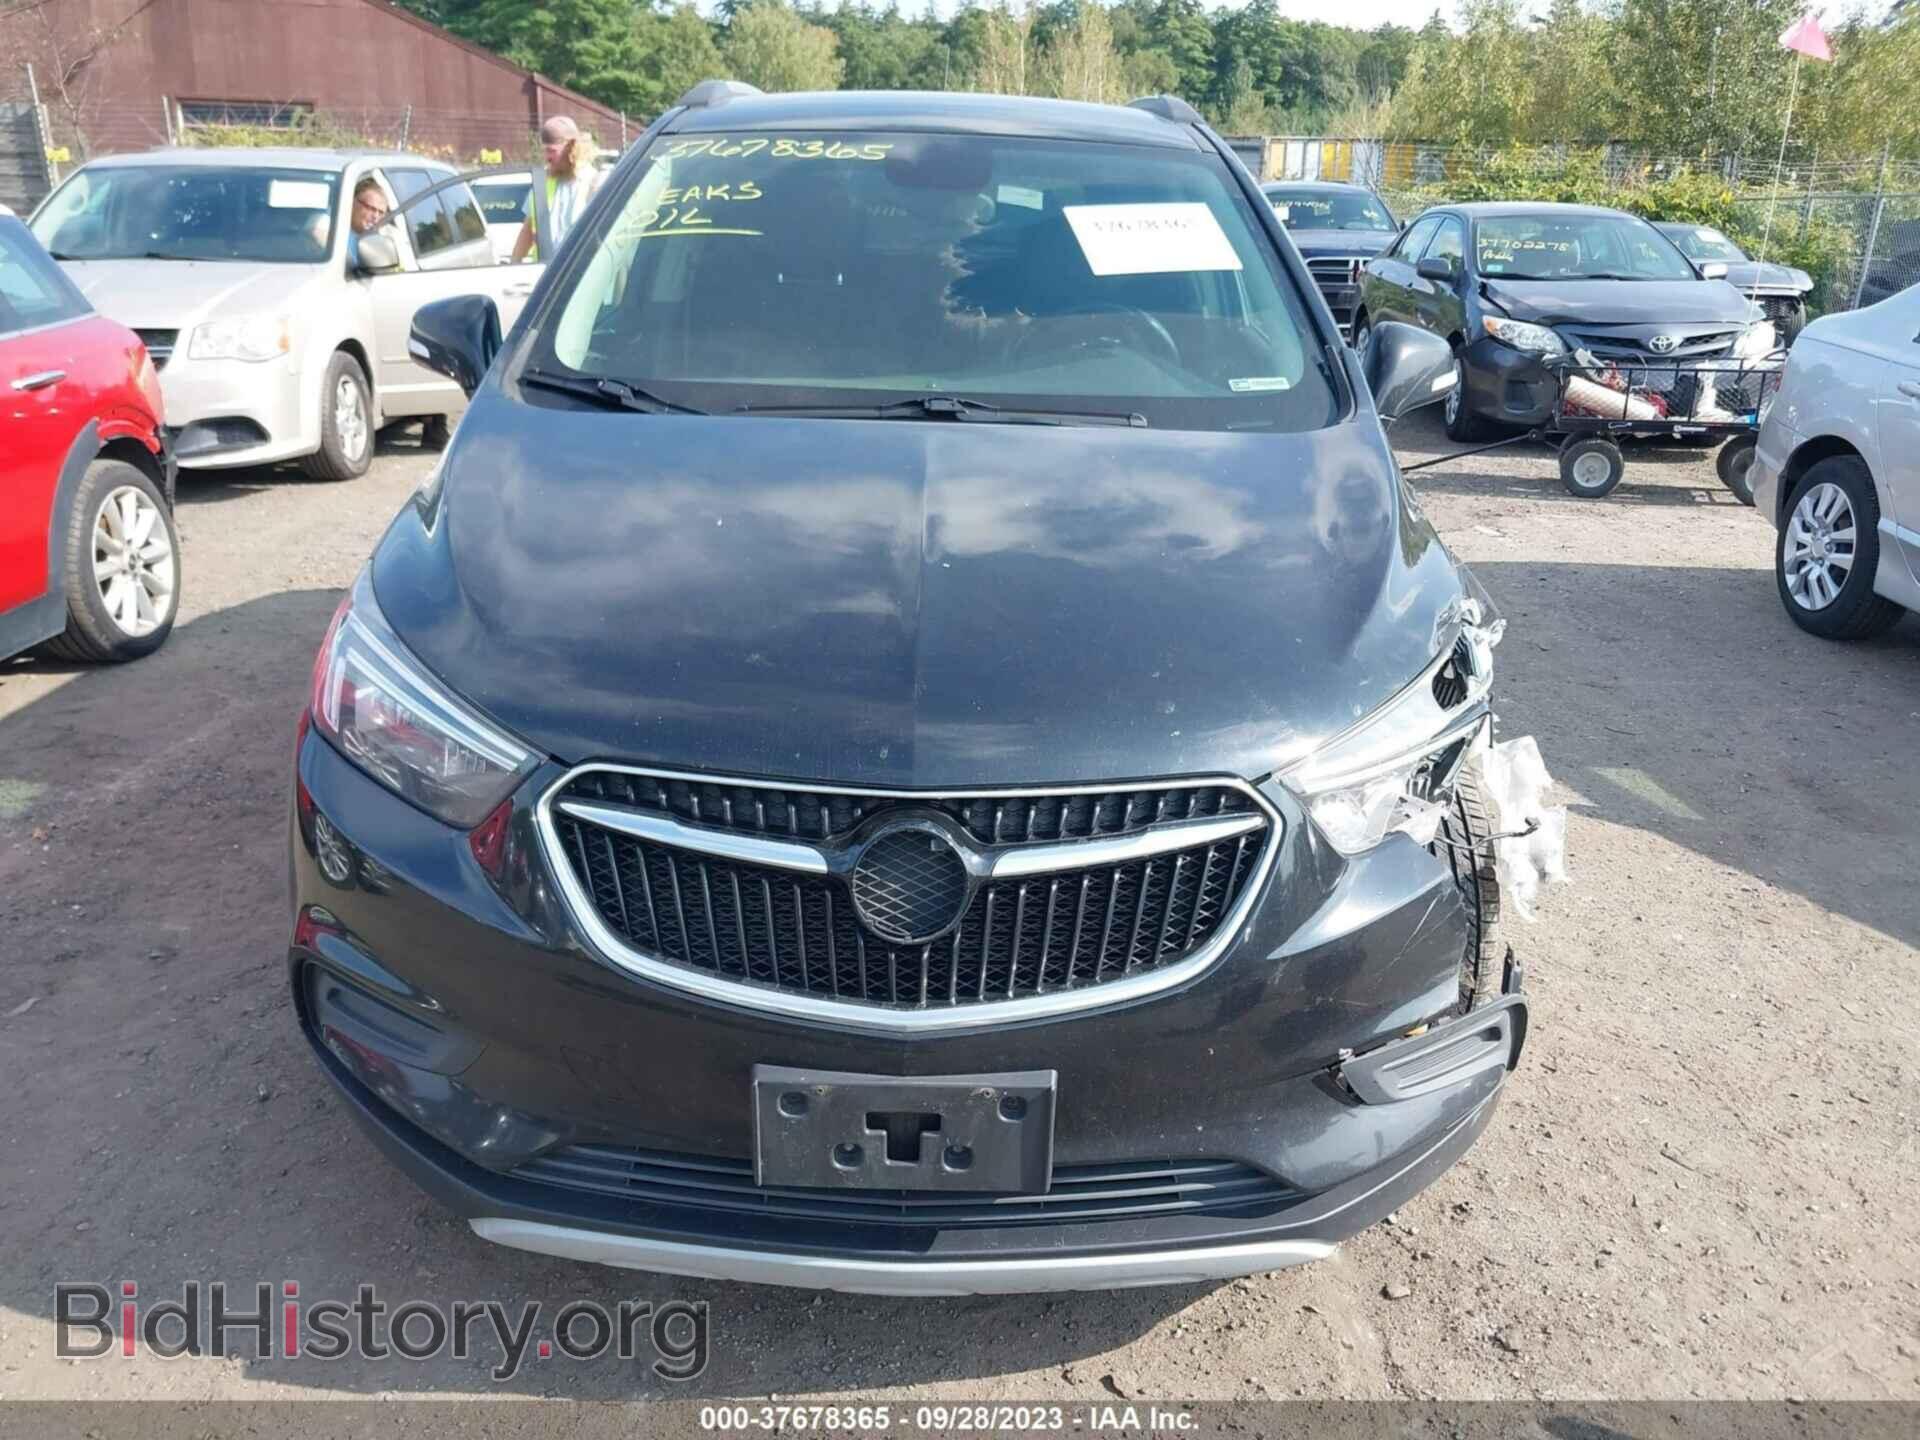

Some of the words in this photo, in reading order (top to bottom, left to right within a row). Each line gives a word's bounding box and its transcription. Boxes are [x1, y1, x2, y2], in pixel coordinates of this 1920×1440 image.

[651, 138, 894, 161] 37678365
[655, 181, 763, 206] EAKS
[630, 207, 712, 230] OIL
